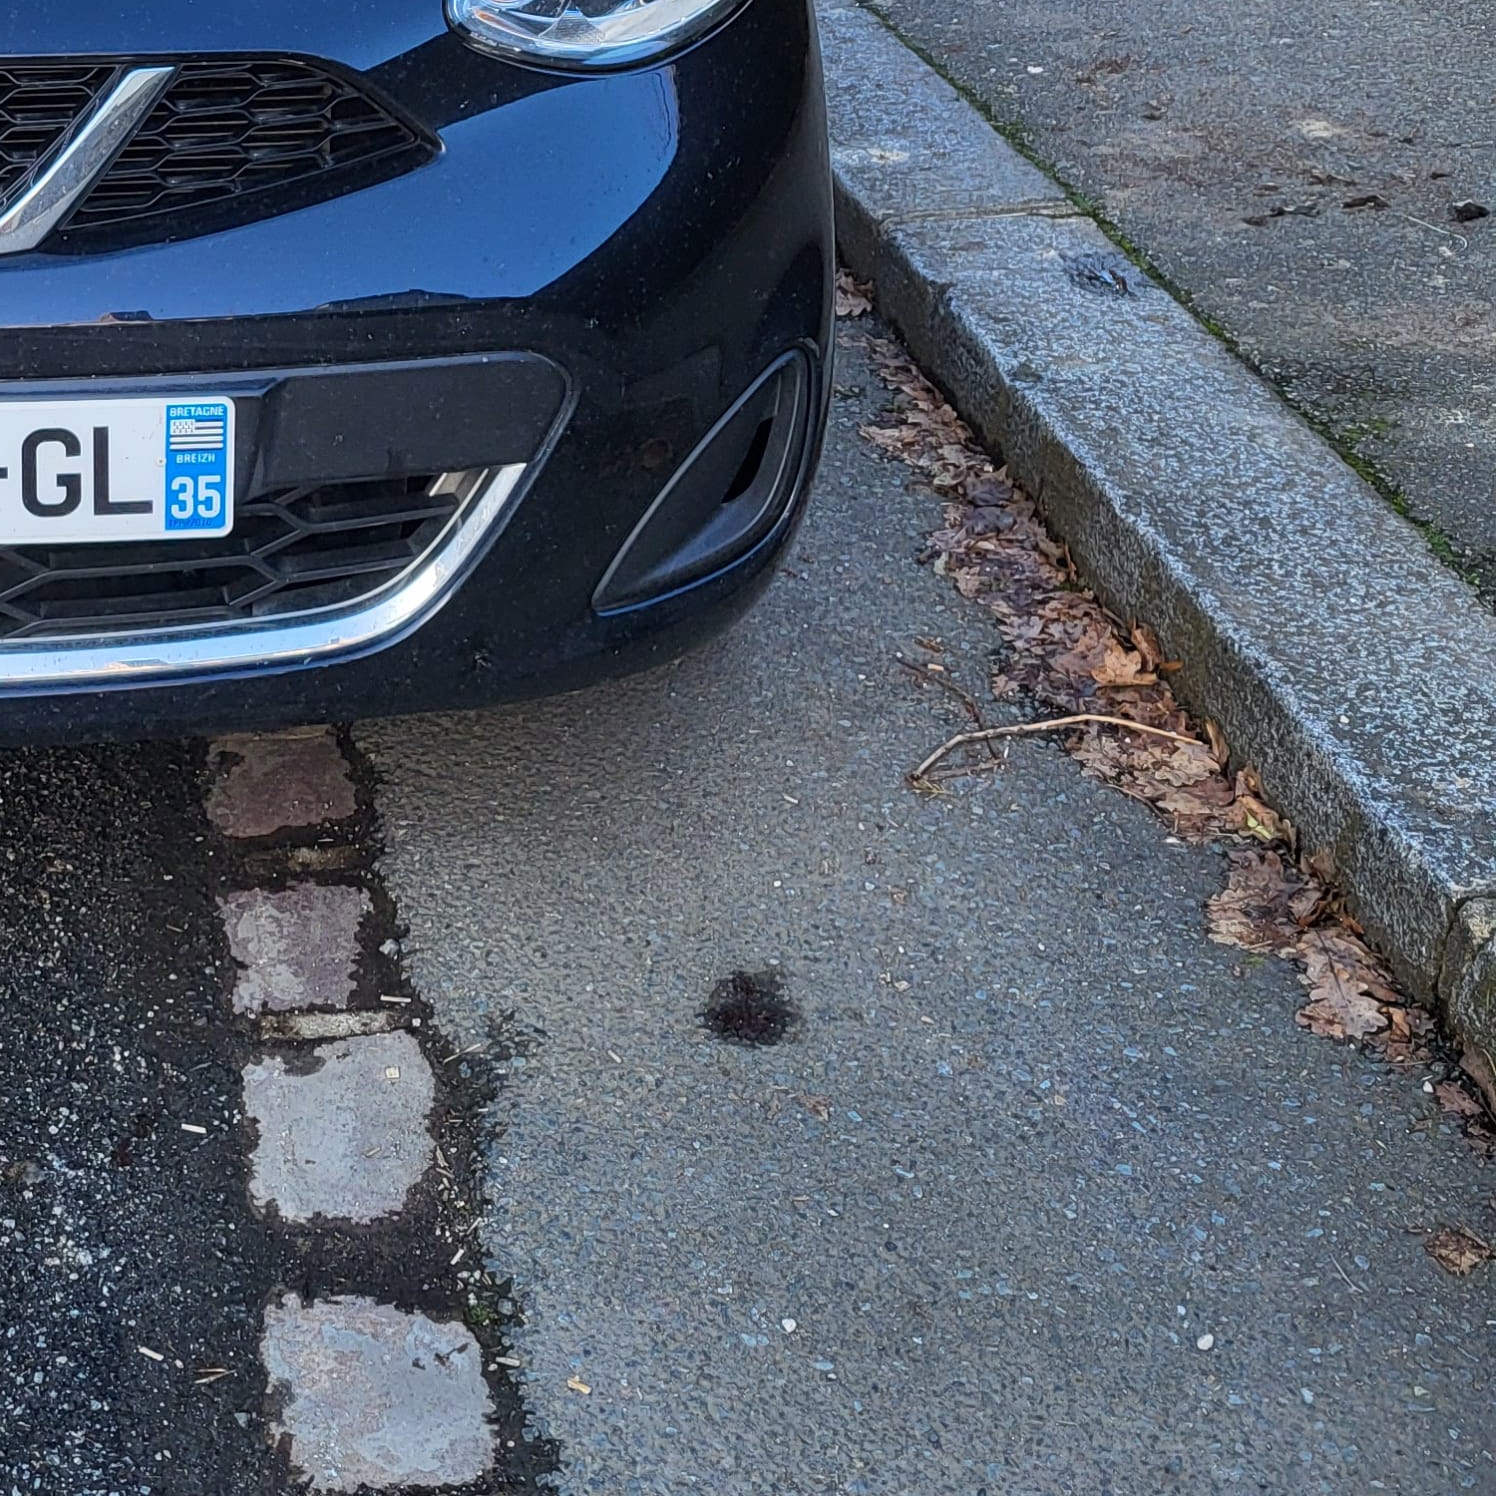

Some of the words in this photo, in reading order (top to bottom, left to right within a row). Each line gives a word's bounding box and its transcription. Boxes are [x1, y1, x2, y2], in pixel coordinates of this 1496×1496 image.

[169, 406, 224, 416] BRETAGNE
[176, 453, 215, 463] BREIZH
[171, 475, 221, 519] 35
